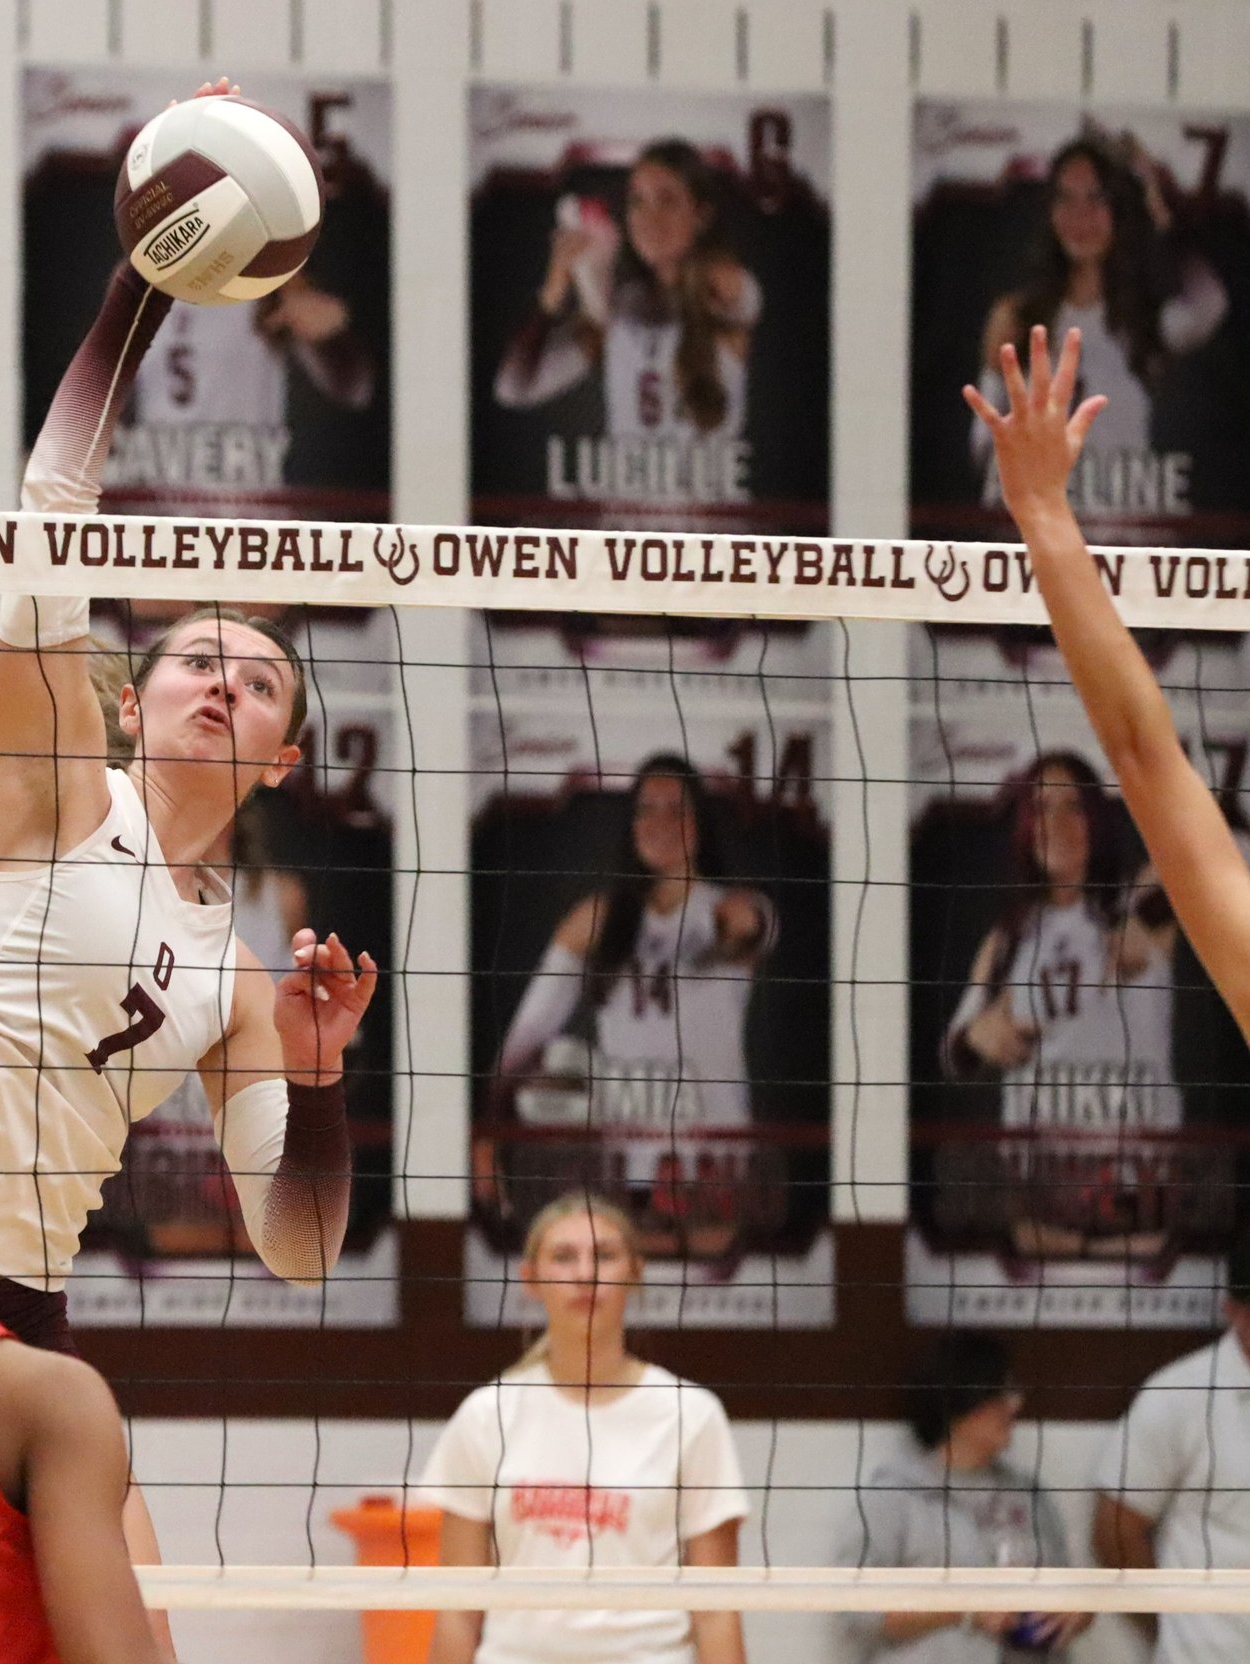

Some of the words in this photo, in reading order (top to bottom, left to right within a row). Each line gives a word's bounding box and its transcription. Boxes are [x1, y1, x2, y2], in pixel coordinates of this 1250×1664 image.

[143, 216, 205, 265] TACHIKARA
[981, 448, 1193, 515] LINE
[43, 522, 364, 572] VOLLEYBALL
[433, 533, 579, 580] OWEN
[604, 538, 915, 589] VOLLEYBALL
[983, 550, 1125, 596] ON
[1149, 555, 1250, 600] VOL
[84, 981, 166, 1075] 7
